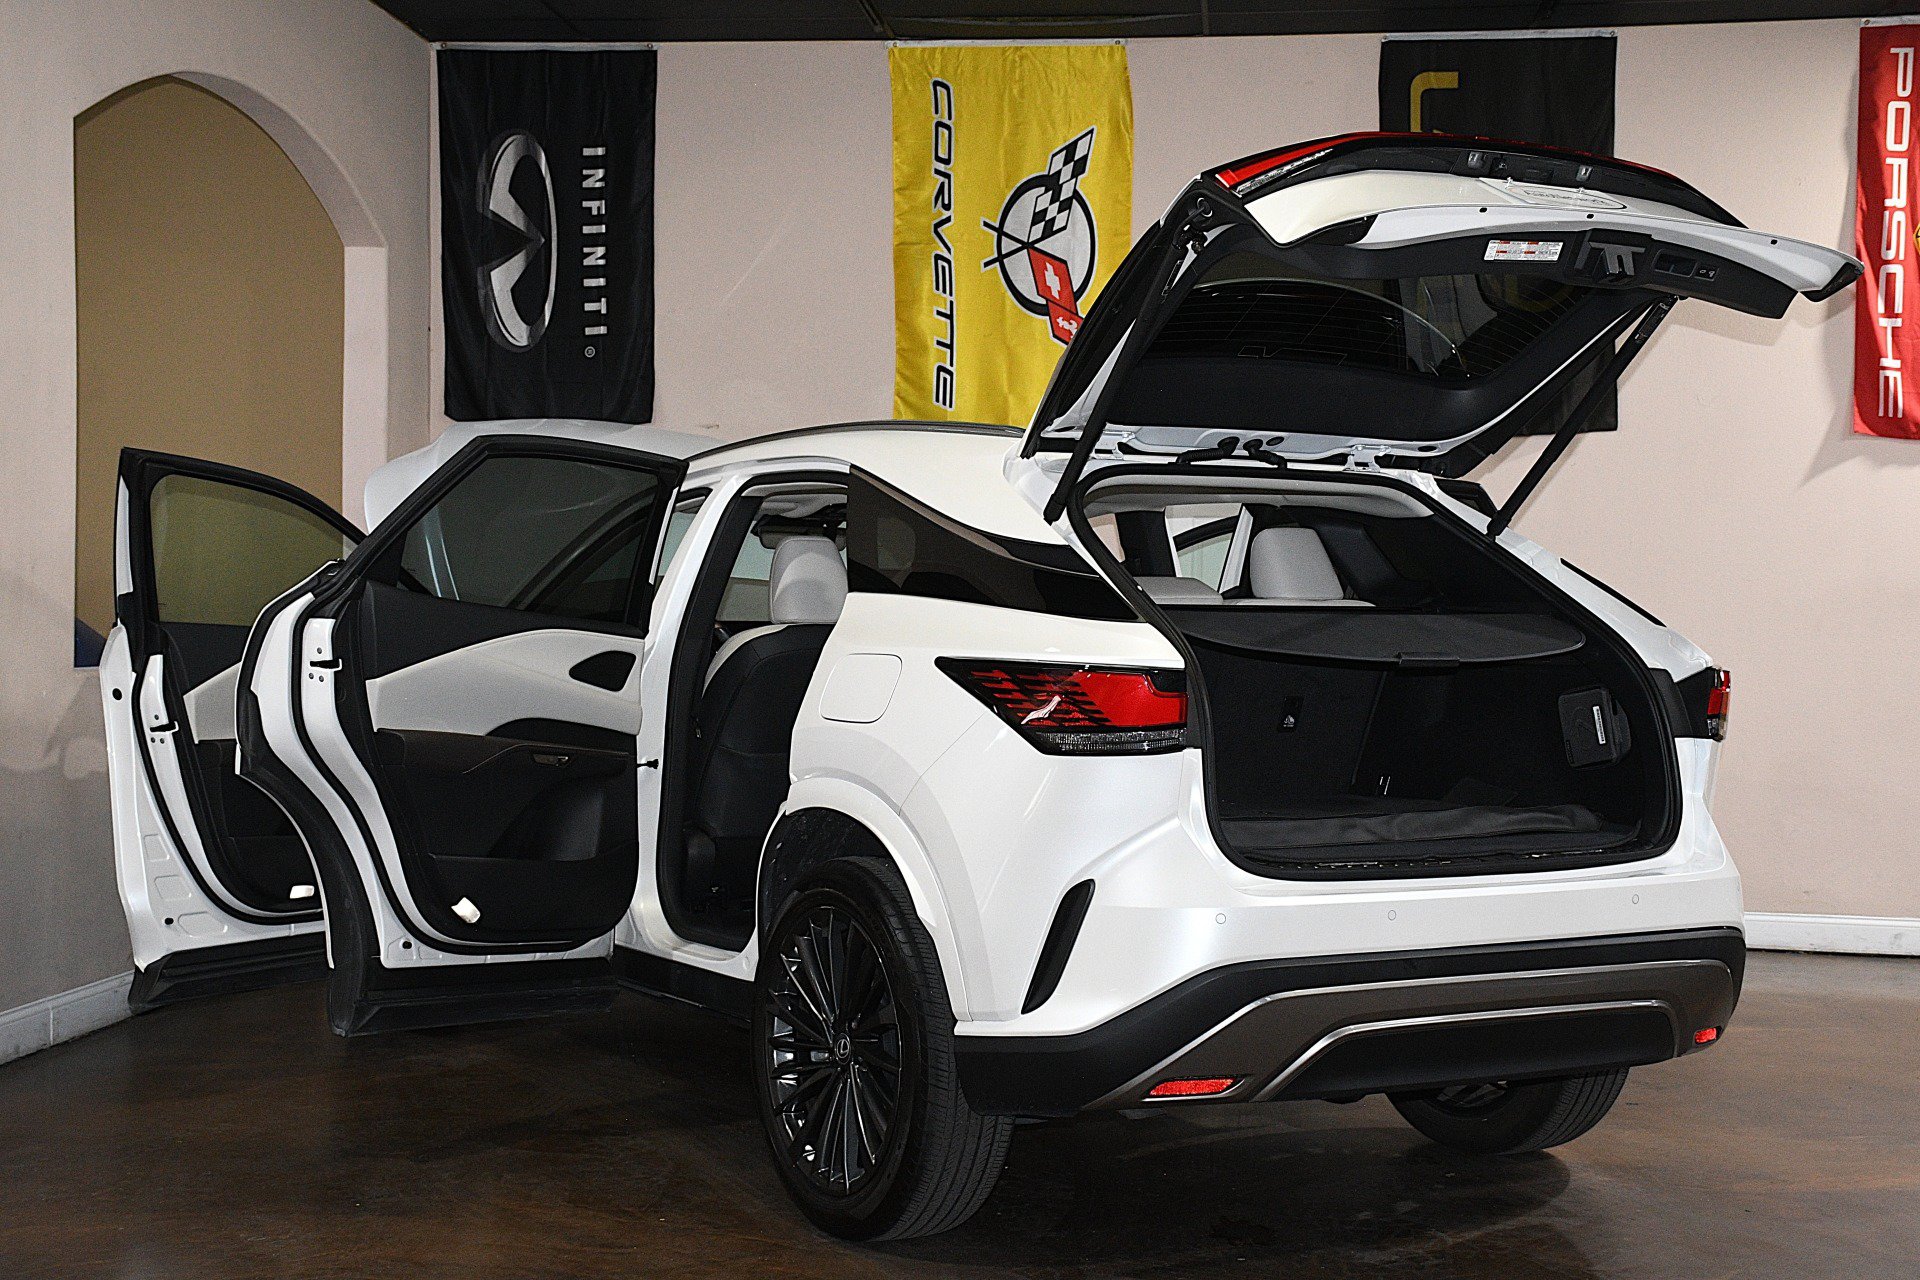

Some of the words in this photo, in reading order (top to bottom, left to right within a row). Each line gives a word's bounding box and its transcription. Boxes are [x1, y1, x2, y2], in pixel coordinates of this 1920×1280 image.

[582, 147, 607, 335] INFINITI
[931, 78, 955, 410] CORVETTE
[1878, 47, 1914, 418] PORSCHE
